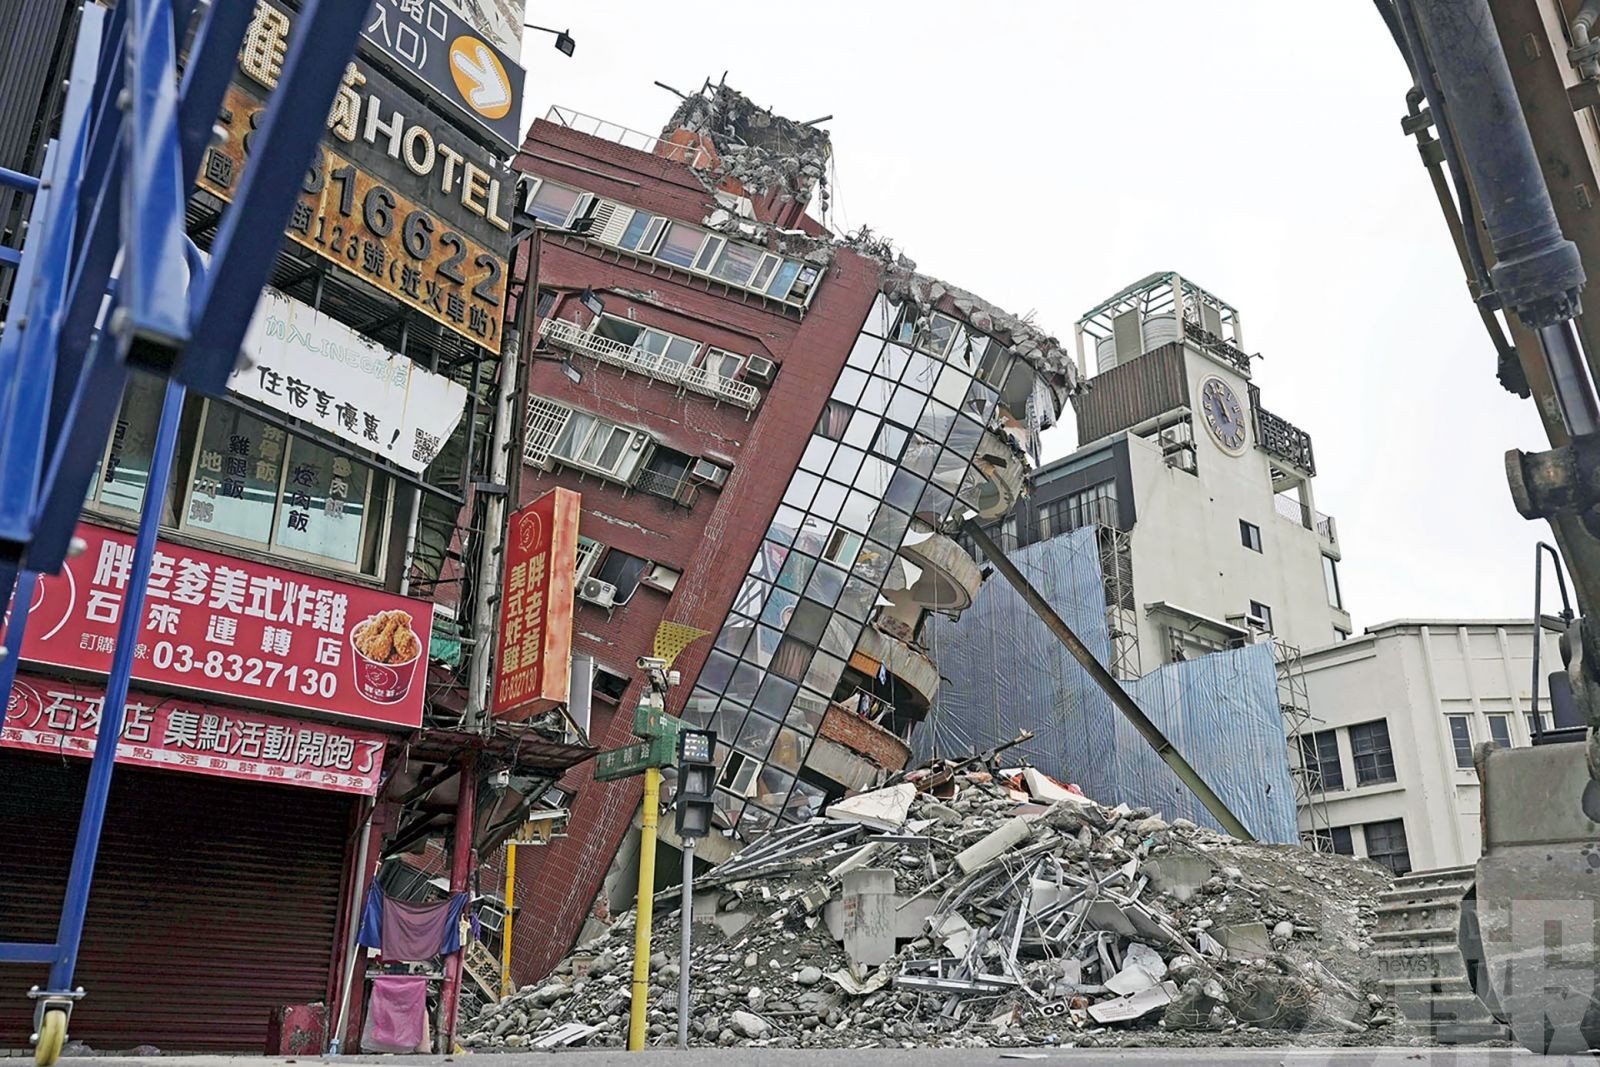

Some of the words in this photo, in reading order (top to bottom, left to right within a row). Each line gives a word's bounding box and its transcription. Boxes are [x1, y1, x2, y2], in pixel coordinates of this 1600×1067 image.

[368, 2, 427, 70] 入口)
[363, 95, 511, 232] HOTEL
[501, 565, 527, 677] 美式炸雞
[521, 551, 546, 668] 胖老爹
[79, 631, 151, 661] 訂購線:
[153, 640, 338, 700] 03-8327130
[499, 667, 538, 703] 03-8327130
[163, 707, 385, 773] 集點活動開跑了
